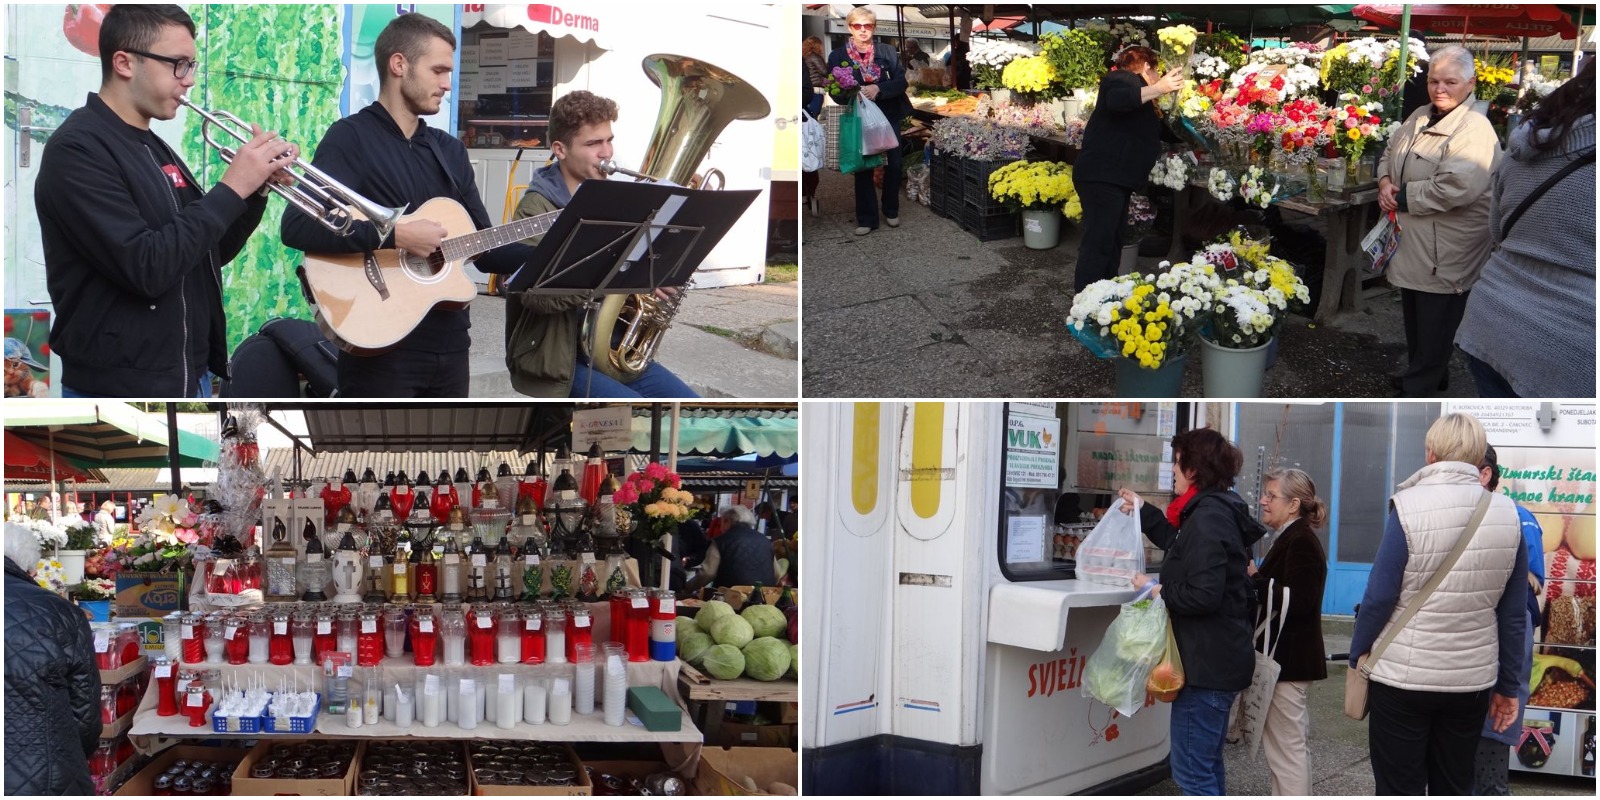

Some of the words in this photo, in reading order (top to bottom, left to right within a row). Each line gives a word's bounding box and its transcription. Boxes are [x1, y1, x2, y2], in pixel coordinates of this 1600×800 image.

[551, 6, 599, 32] Derma
[1008, 428, 1042, 449] VUK
[1547, 486, 1593, 504] hrane
[145, 591, 176, 606] erby
